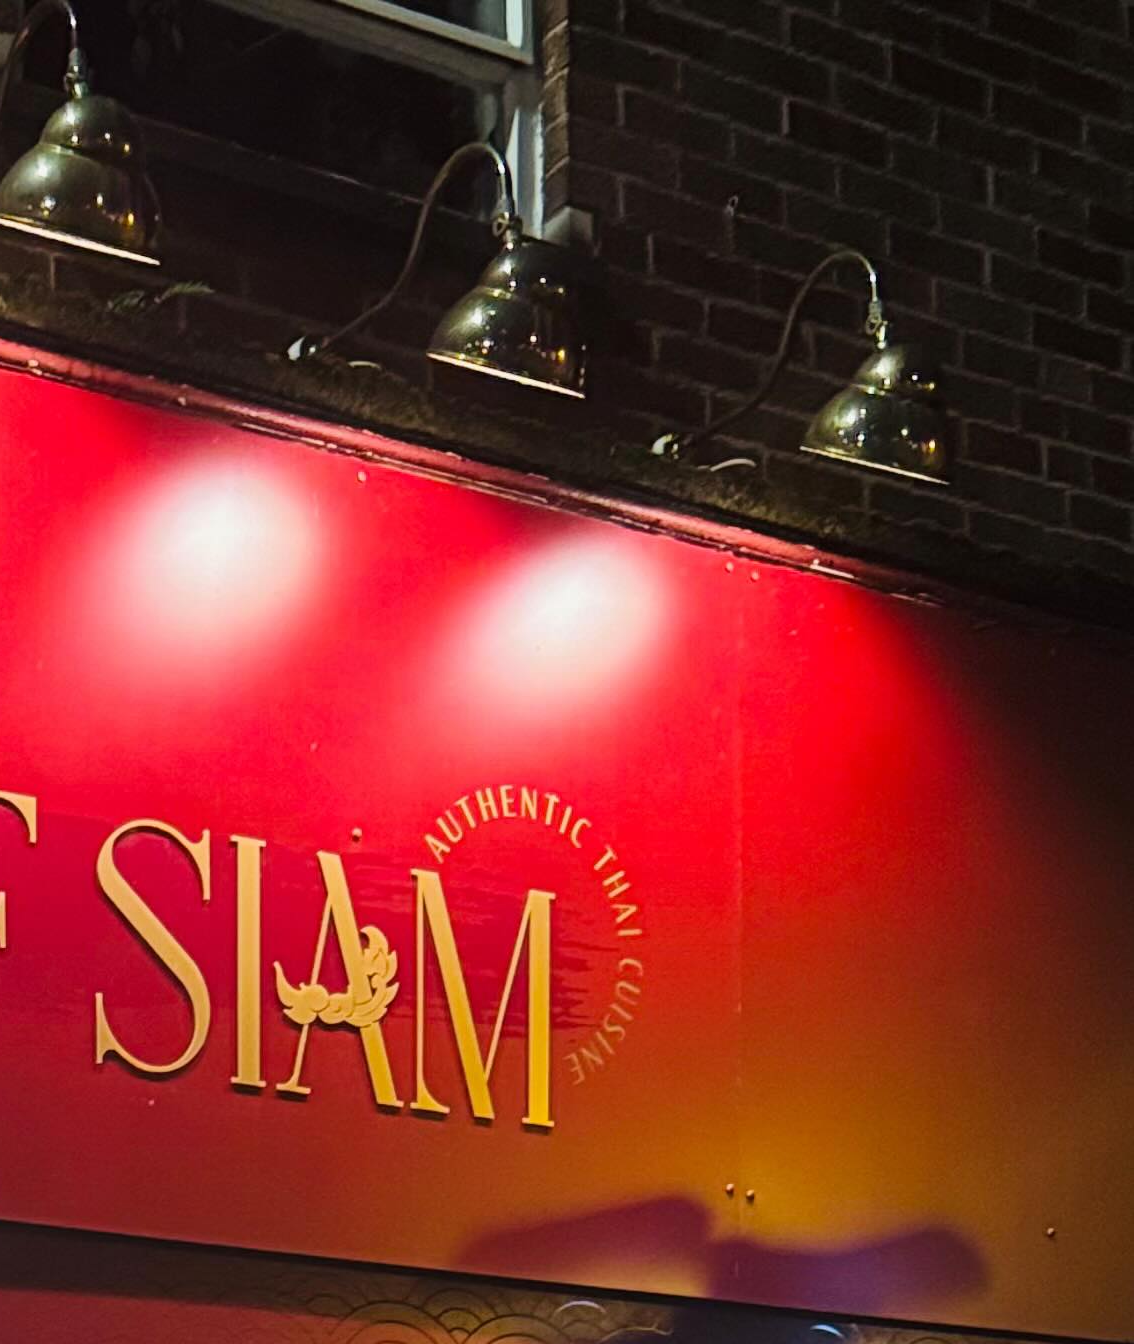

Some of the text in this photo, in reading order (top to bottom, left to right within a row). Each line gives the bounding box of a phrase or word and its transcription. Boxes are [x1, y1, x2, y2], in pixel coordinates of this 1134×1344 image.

[96, 819, 556, 1128] SIAM
[424, 784, 644, 1086] AUTHENTIC THAI CUISINE
